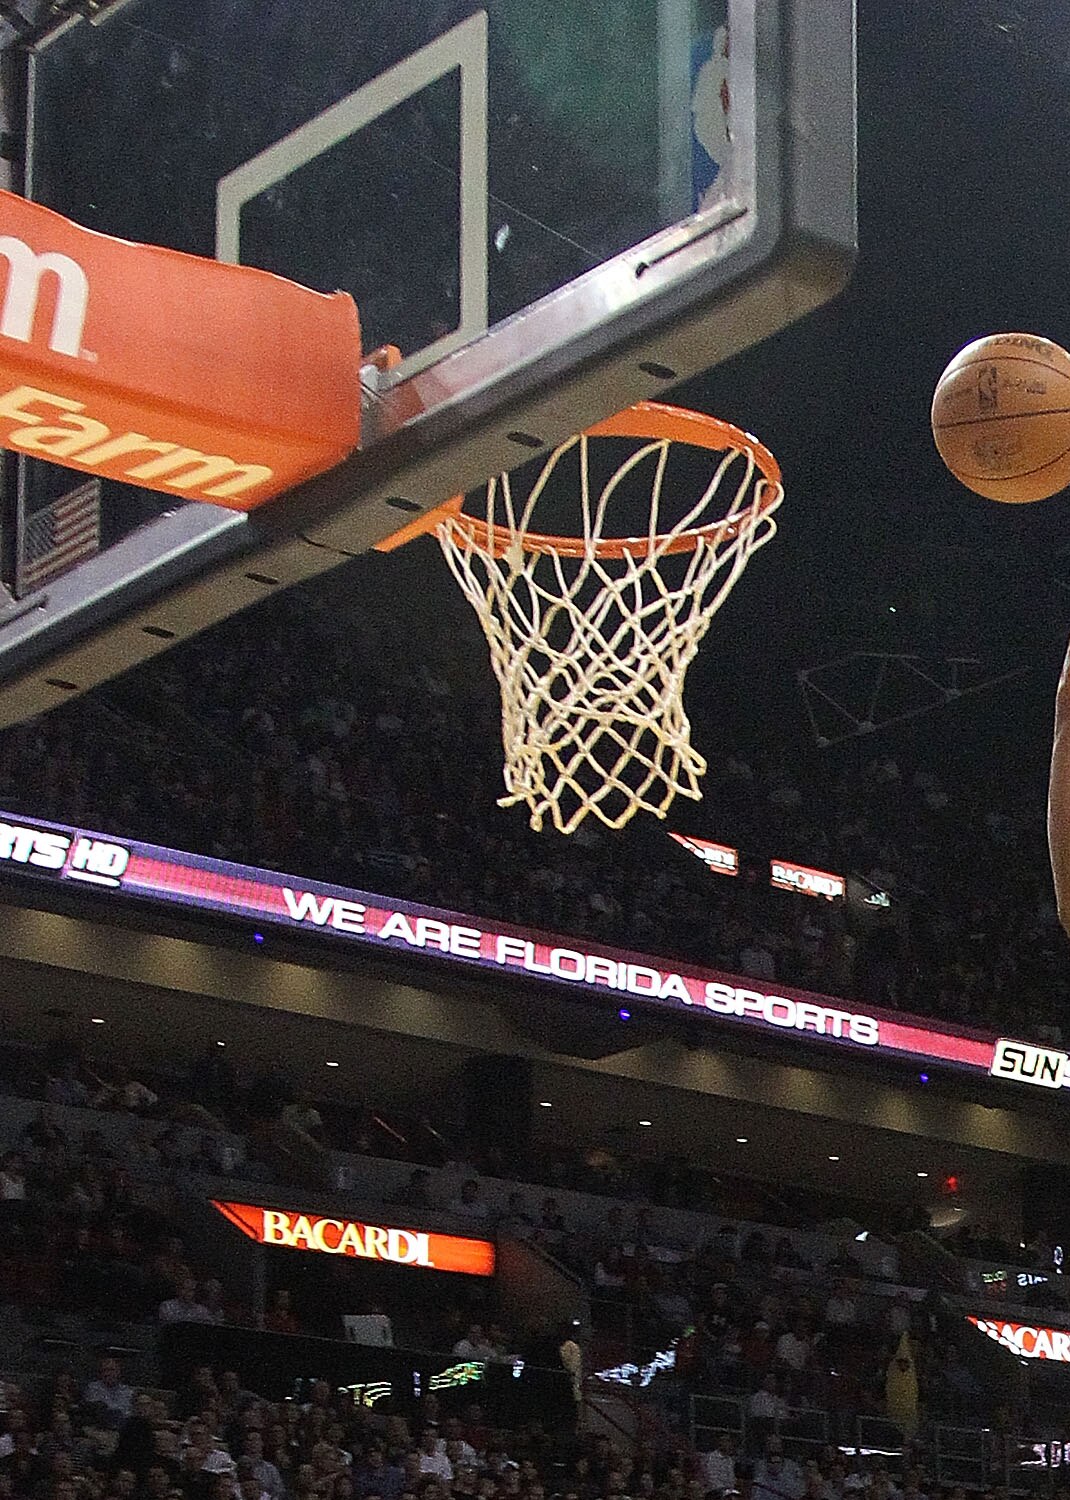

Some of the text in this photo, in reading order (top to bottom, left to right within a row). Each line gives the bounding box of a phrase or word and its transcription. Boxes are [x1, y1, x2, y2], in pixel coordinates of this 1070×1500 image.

[0, 385, 273, 498] Farm
[72, 838, 130, 877] HD
[282, 887, 880, 1046] WE ARE FLORIDA SPORTS
[1000, 1047, 1060, 1082] SUN
[262, 1210, 434, 1267] BACARDI
